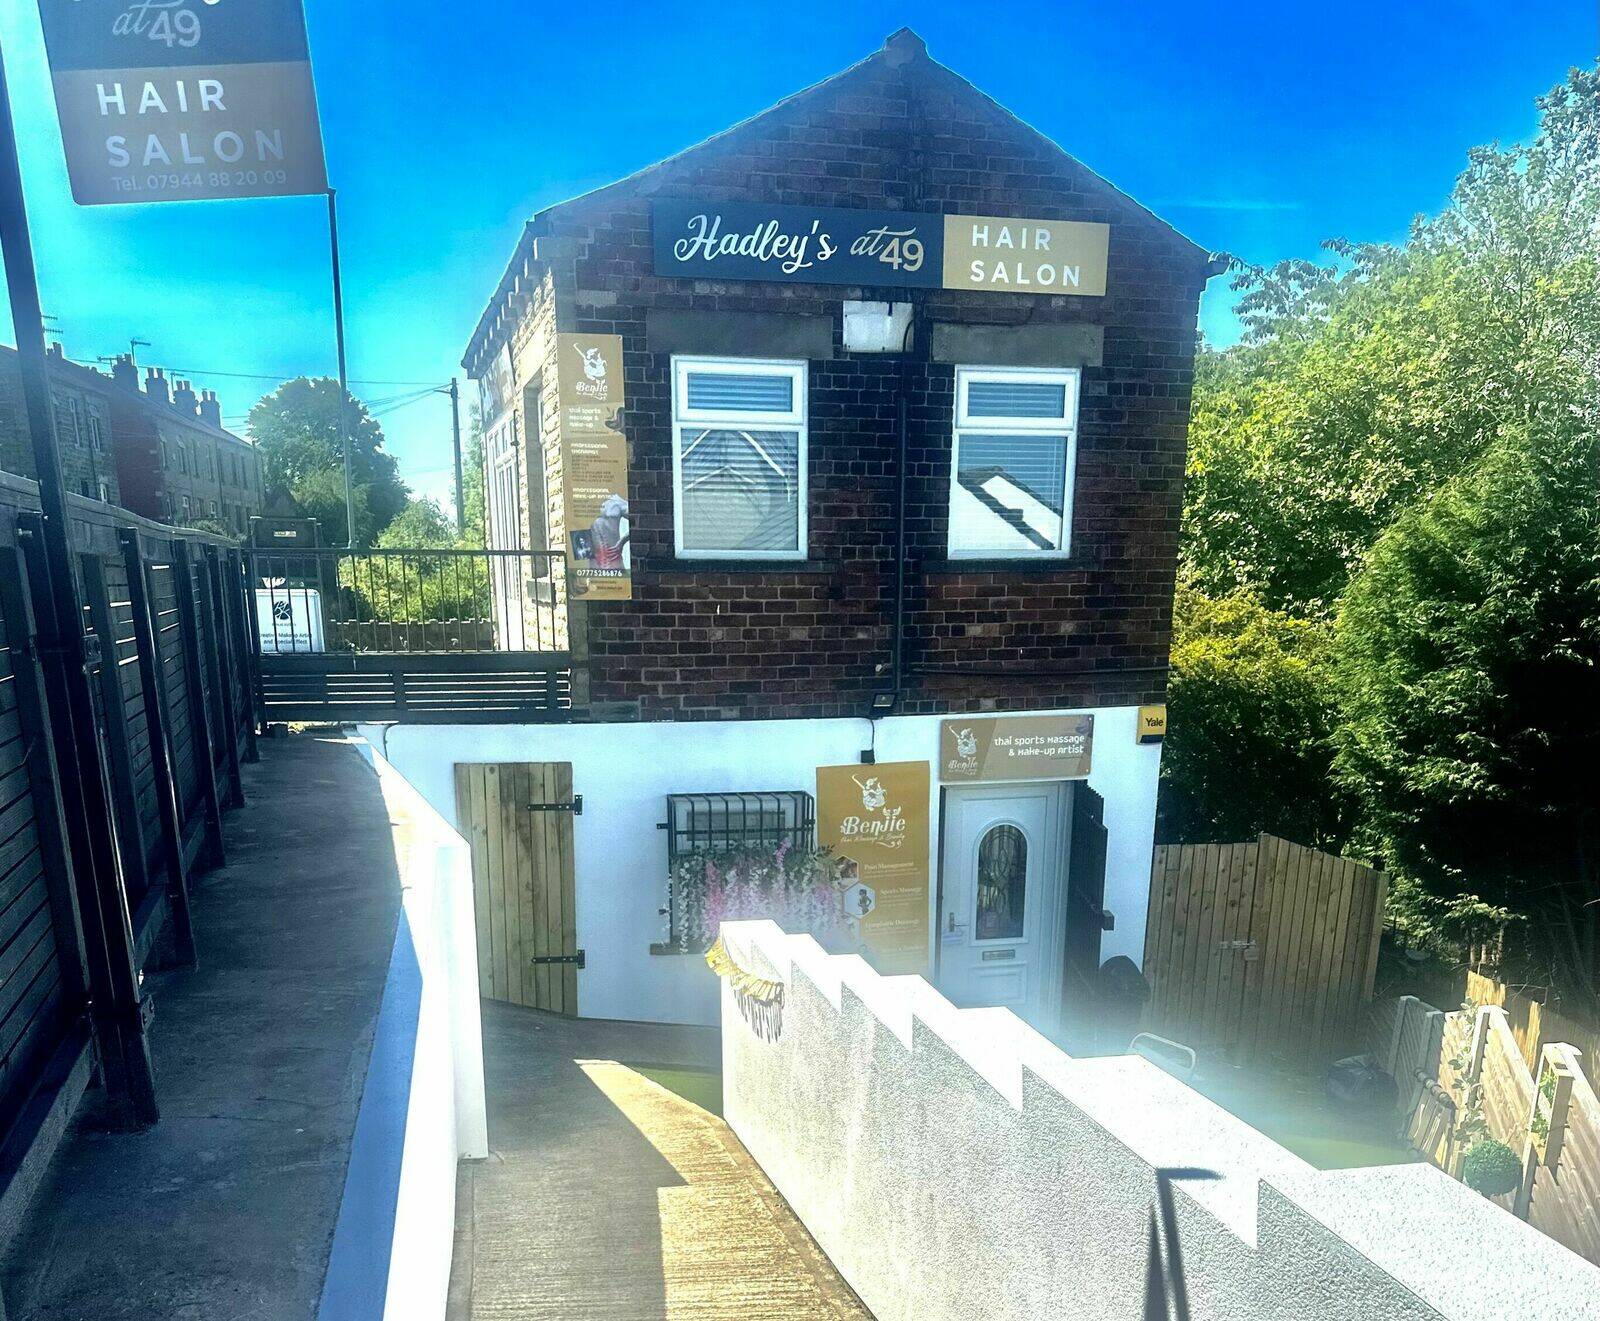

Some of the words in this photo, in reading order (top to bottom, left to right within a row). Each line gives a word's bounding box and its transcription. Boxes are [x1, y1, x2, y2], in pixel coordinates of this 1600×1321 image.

[96, 79, 227, 116] HAIR
[105, 129, 285, 168] SALON
[112, 176, 142, 191] Tel.
[146, 174, 204, 190] 07944
[208, 171, 231, 187] 88
[235, 170, 258, 186] 20
[263, 169, 287, 185] 09
[673, 213, 838, 275] Hadley's
[972, 224, 1051, 250] HAIR
[970, 259, 1080, 287] SALON
[1145, 717, 1164, 727] Yale
[1008, 748, 1015, 756] &
[1014, 736, 1045, 746] sports
